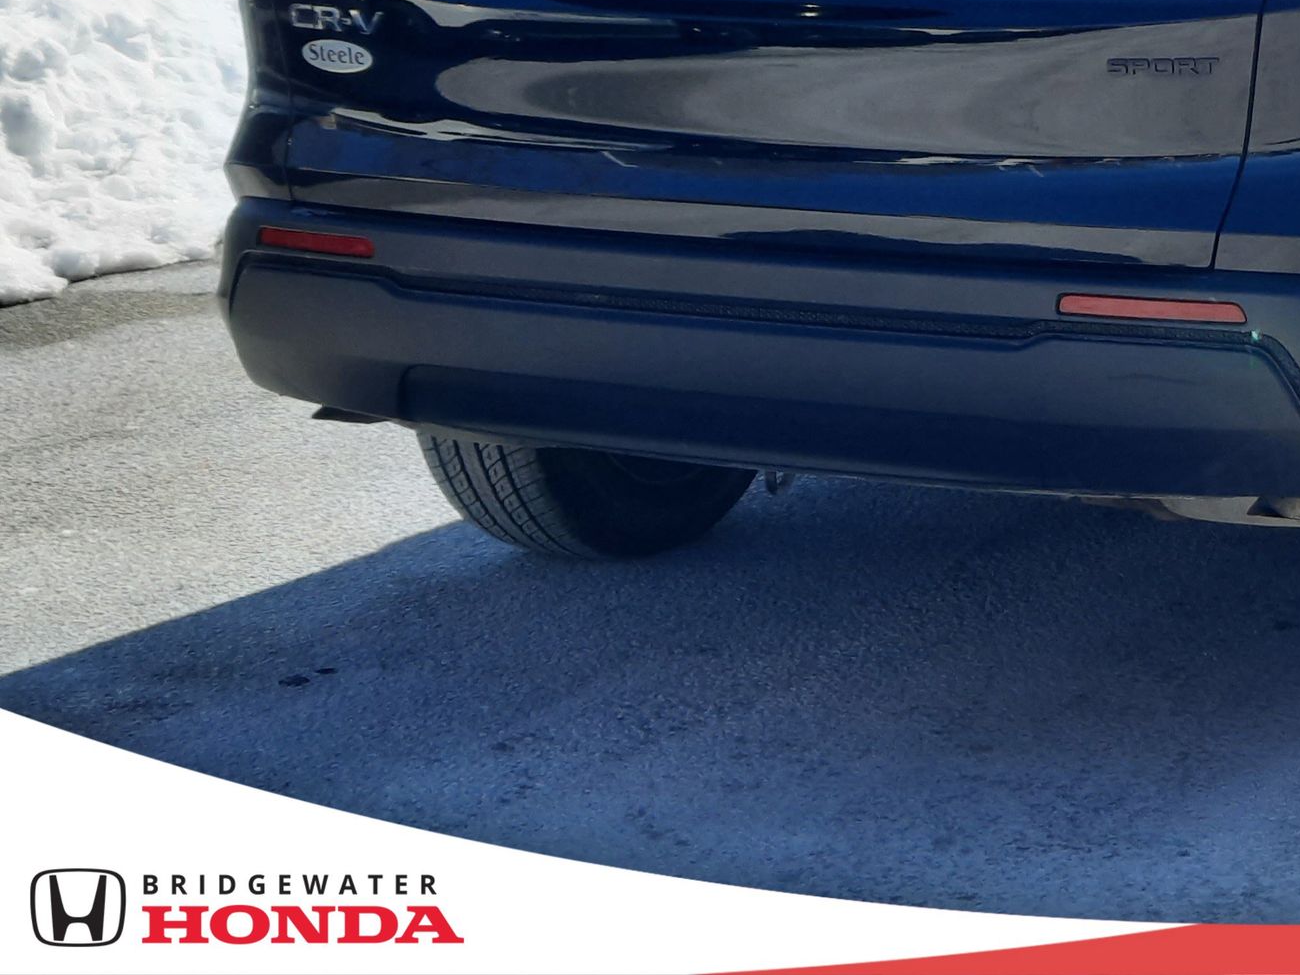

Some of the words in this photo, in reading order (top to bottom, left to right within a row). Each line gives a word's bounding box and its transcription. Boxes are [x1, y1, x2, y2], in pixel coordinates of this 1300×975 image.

[290, 3, 384, 35] CR-V
[308, 43, 365, 66] Steele
[1106, 57, 1220, 75] SPORT
